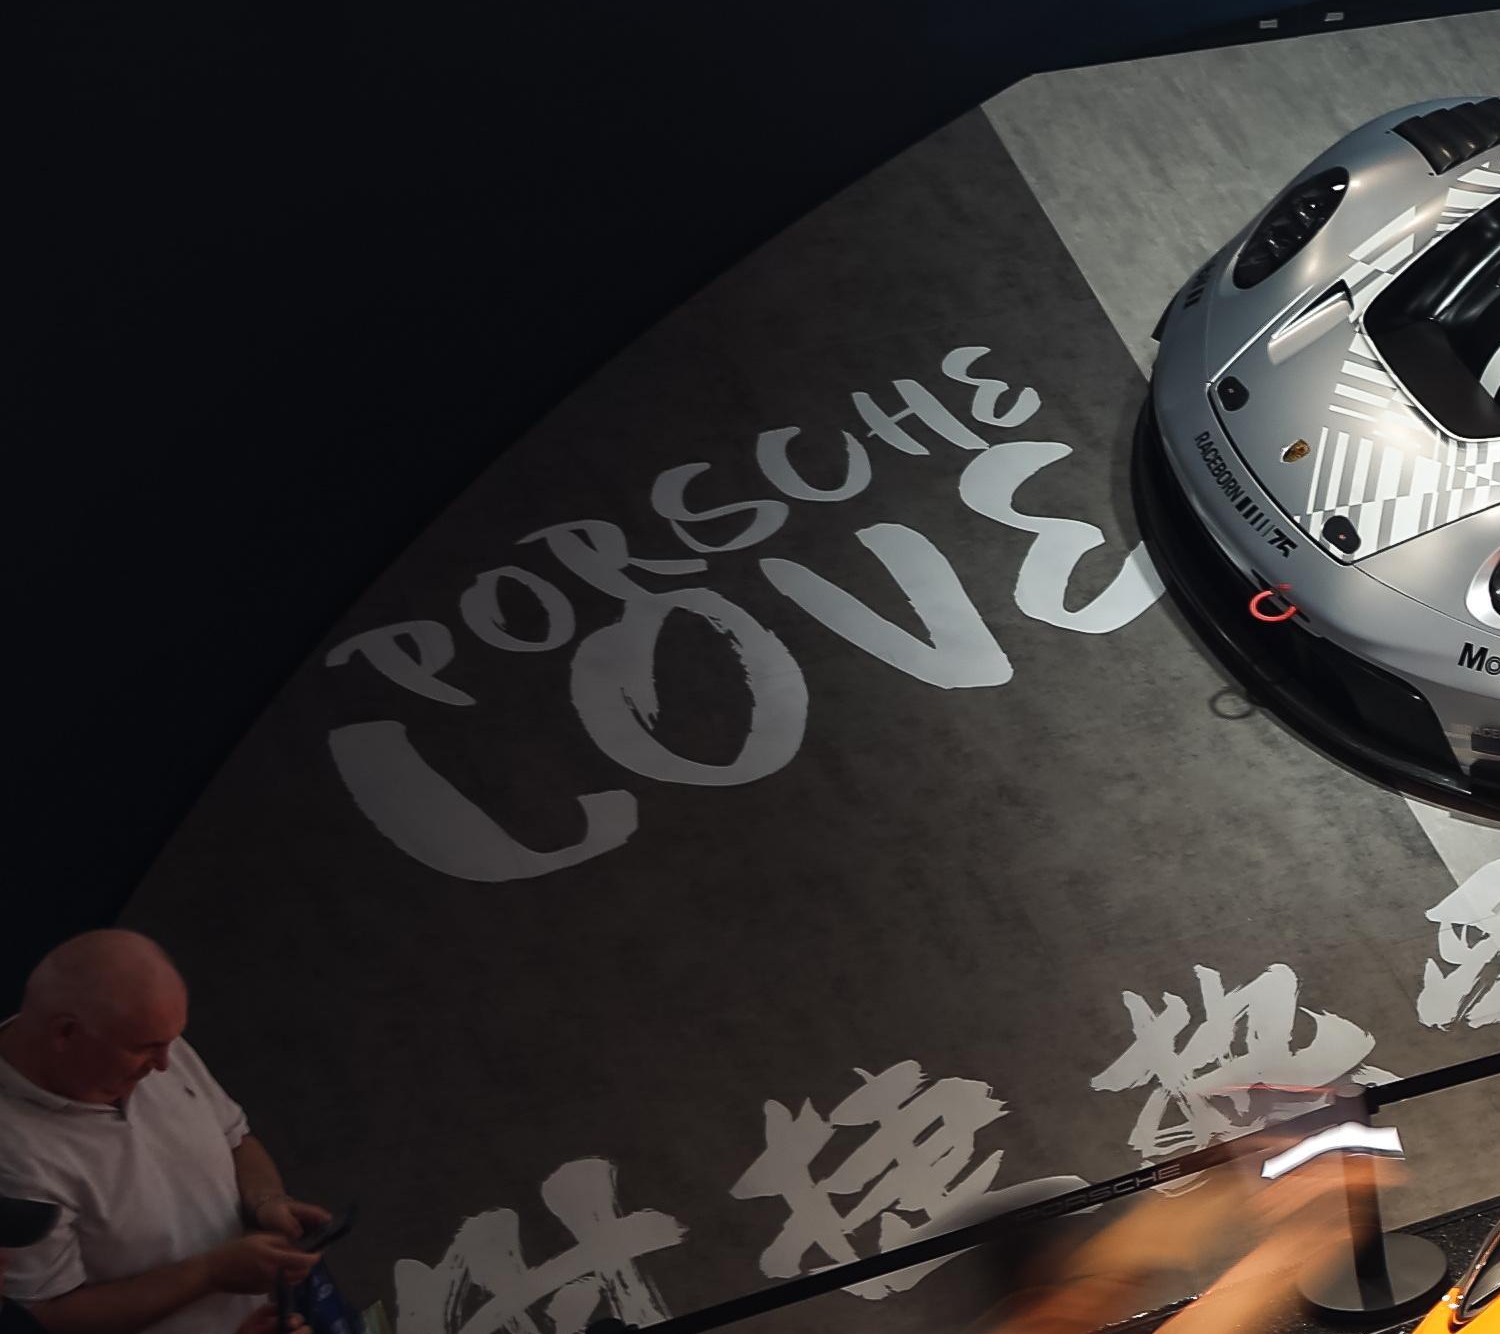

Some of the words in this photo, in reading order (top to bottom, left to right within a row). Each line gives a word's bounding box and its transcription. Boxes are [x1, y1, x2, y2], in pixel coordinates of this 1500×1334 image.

[326, 346, 1042, 706] PORSCHE
[328, 440, 1166, 883] LOVE
[1193, 430, 1244, 503] RACEBORN
[1268, 528, 1298, 559] 75
